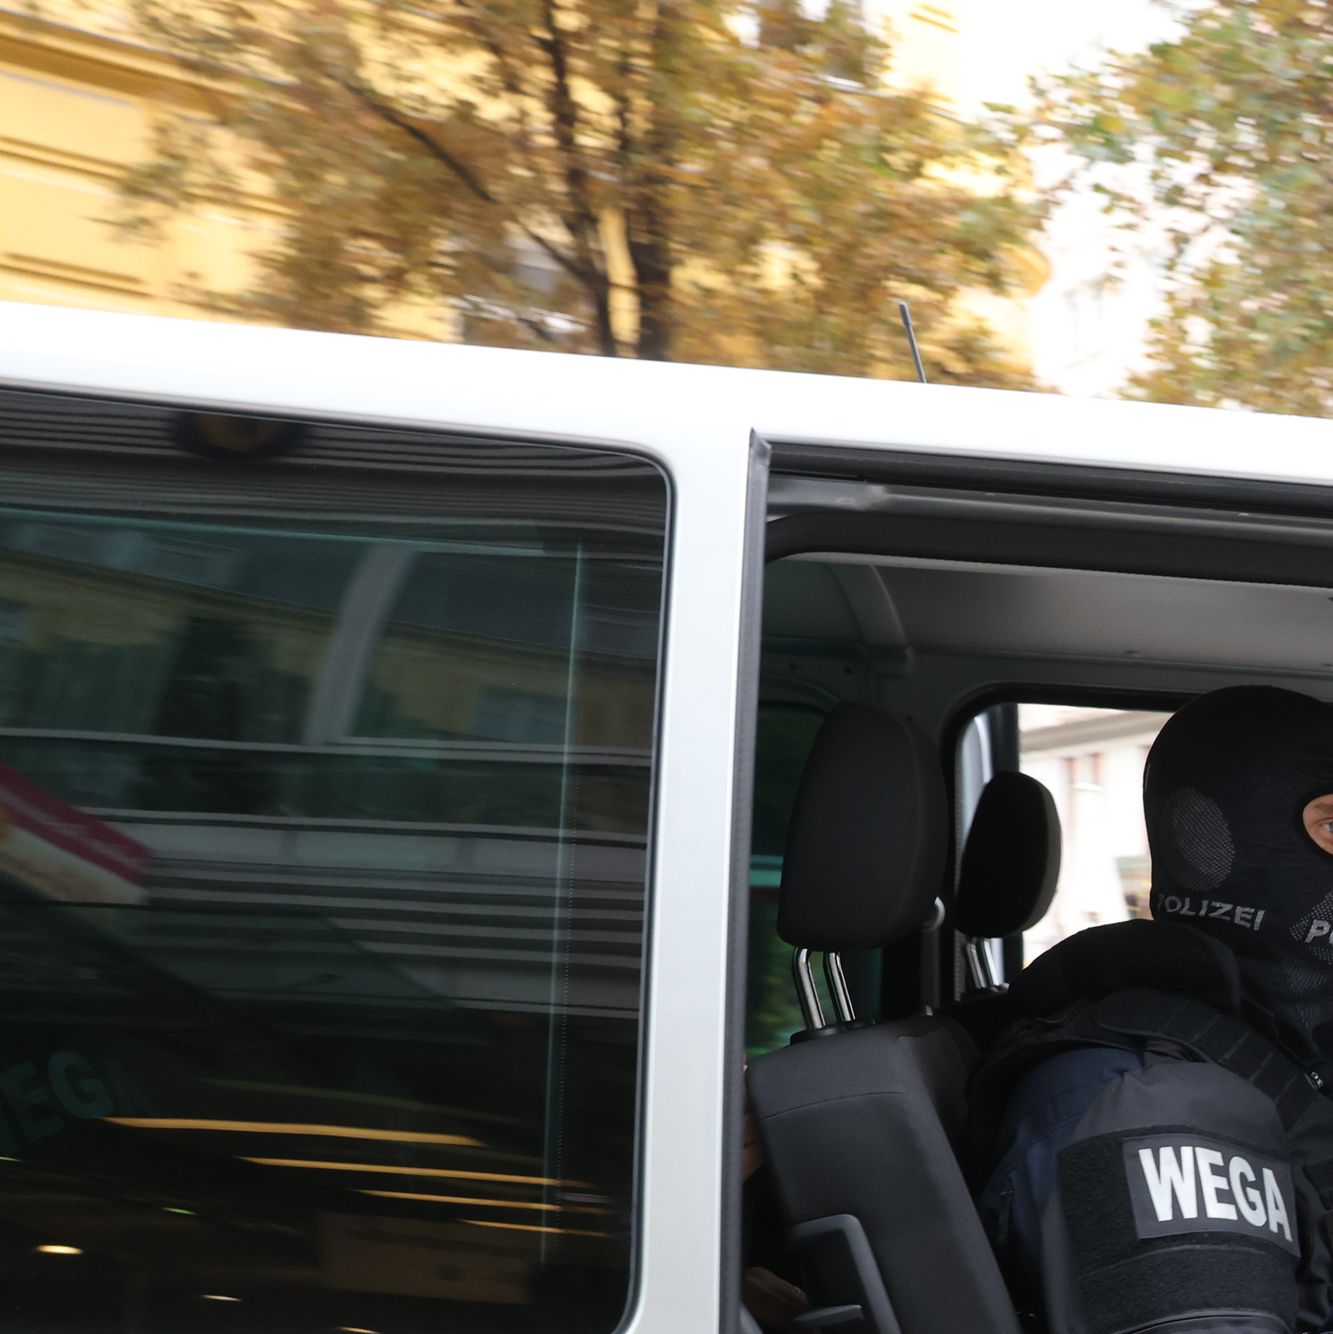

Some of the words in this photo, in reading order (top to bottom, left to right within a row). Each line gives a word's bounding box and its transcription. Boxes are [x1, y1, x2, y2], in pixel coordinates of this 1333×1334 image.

[1157, 894, 1265, 931] OLIZEI
[0, 1051, 153, 1153] EGA
[1138, 1146, 1293, 1242] WEGA
